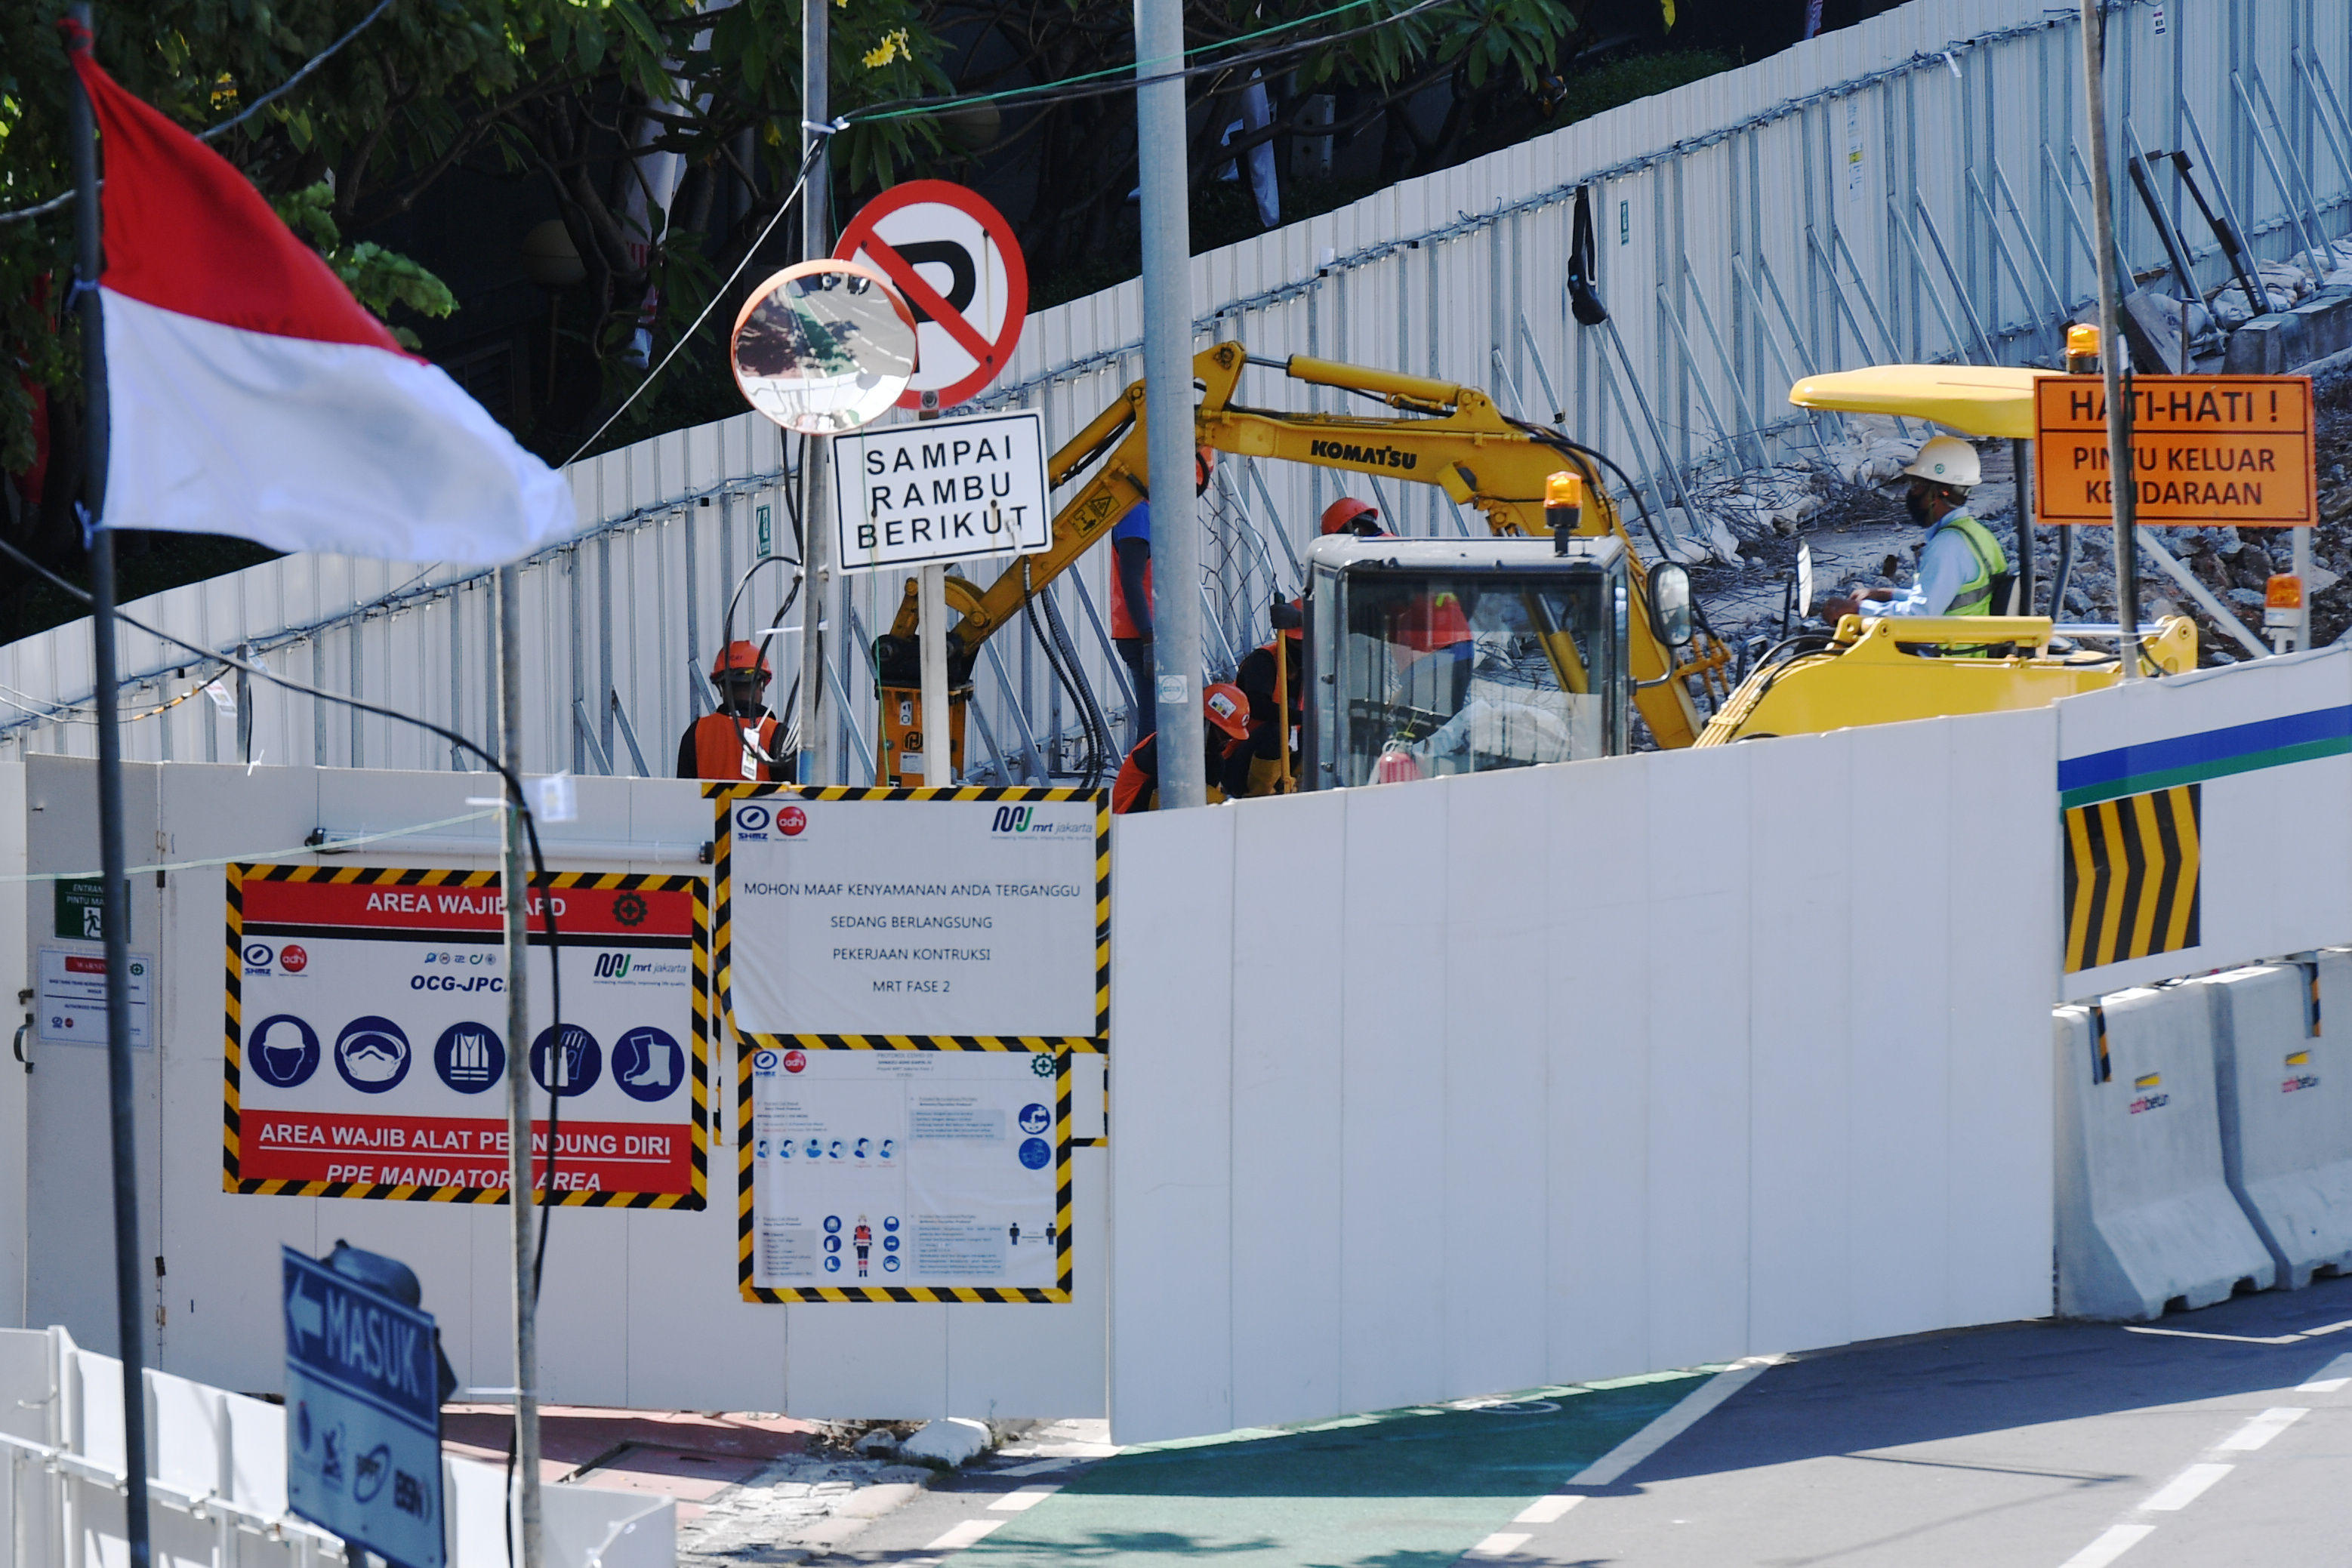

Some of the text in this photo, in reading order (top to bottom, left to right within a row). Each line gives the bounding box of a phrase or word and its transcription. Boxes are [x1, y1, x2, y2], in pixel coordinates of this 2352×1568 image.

[866, 435, 1012, 476] SAMPAI
[1311, 439, 1418, 470] KOMATSU
[2073, 447, 2276, 473] PINU KELUAR
[871, 471, 1011, 510] RAMBU
[2086, 481, 2262, 506] KEDARAAN
[857, 506, 1028, 550] BERIKUT
[1032, 822, 1093, 835] mrt jakarta
[73, 884, 103, 893] ENTRAN
[744, 884, 1081, 898] MOHON MAAF KENYAMANAN ANDA TERGANGGU
[366, 892, 432, 913] AREA
[831, 916, 993, 929] SEDANG BERLANGSUNG
[833, 948, 991, 961] PEKERJAAN KONTRUKSI
[633, 963, 687, 975] mrt jakarta
[410, 975, 507, 992] OCG-JPC
[873, 981, 951, 993] MRT FASE 2
[260, 1123, 670, 1155] AREA WAJIB ALAT PENDUNG DIRI
[326, 1165, 601, 1191] PPE MANDATOR AREA
[326, 1287, 419, 1398] MASUK
